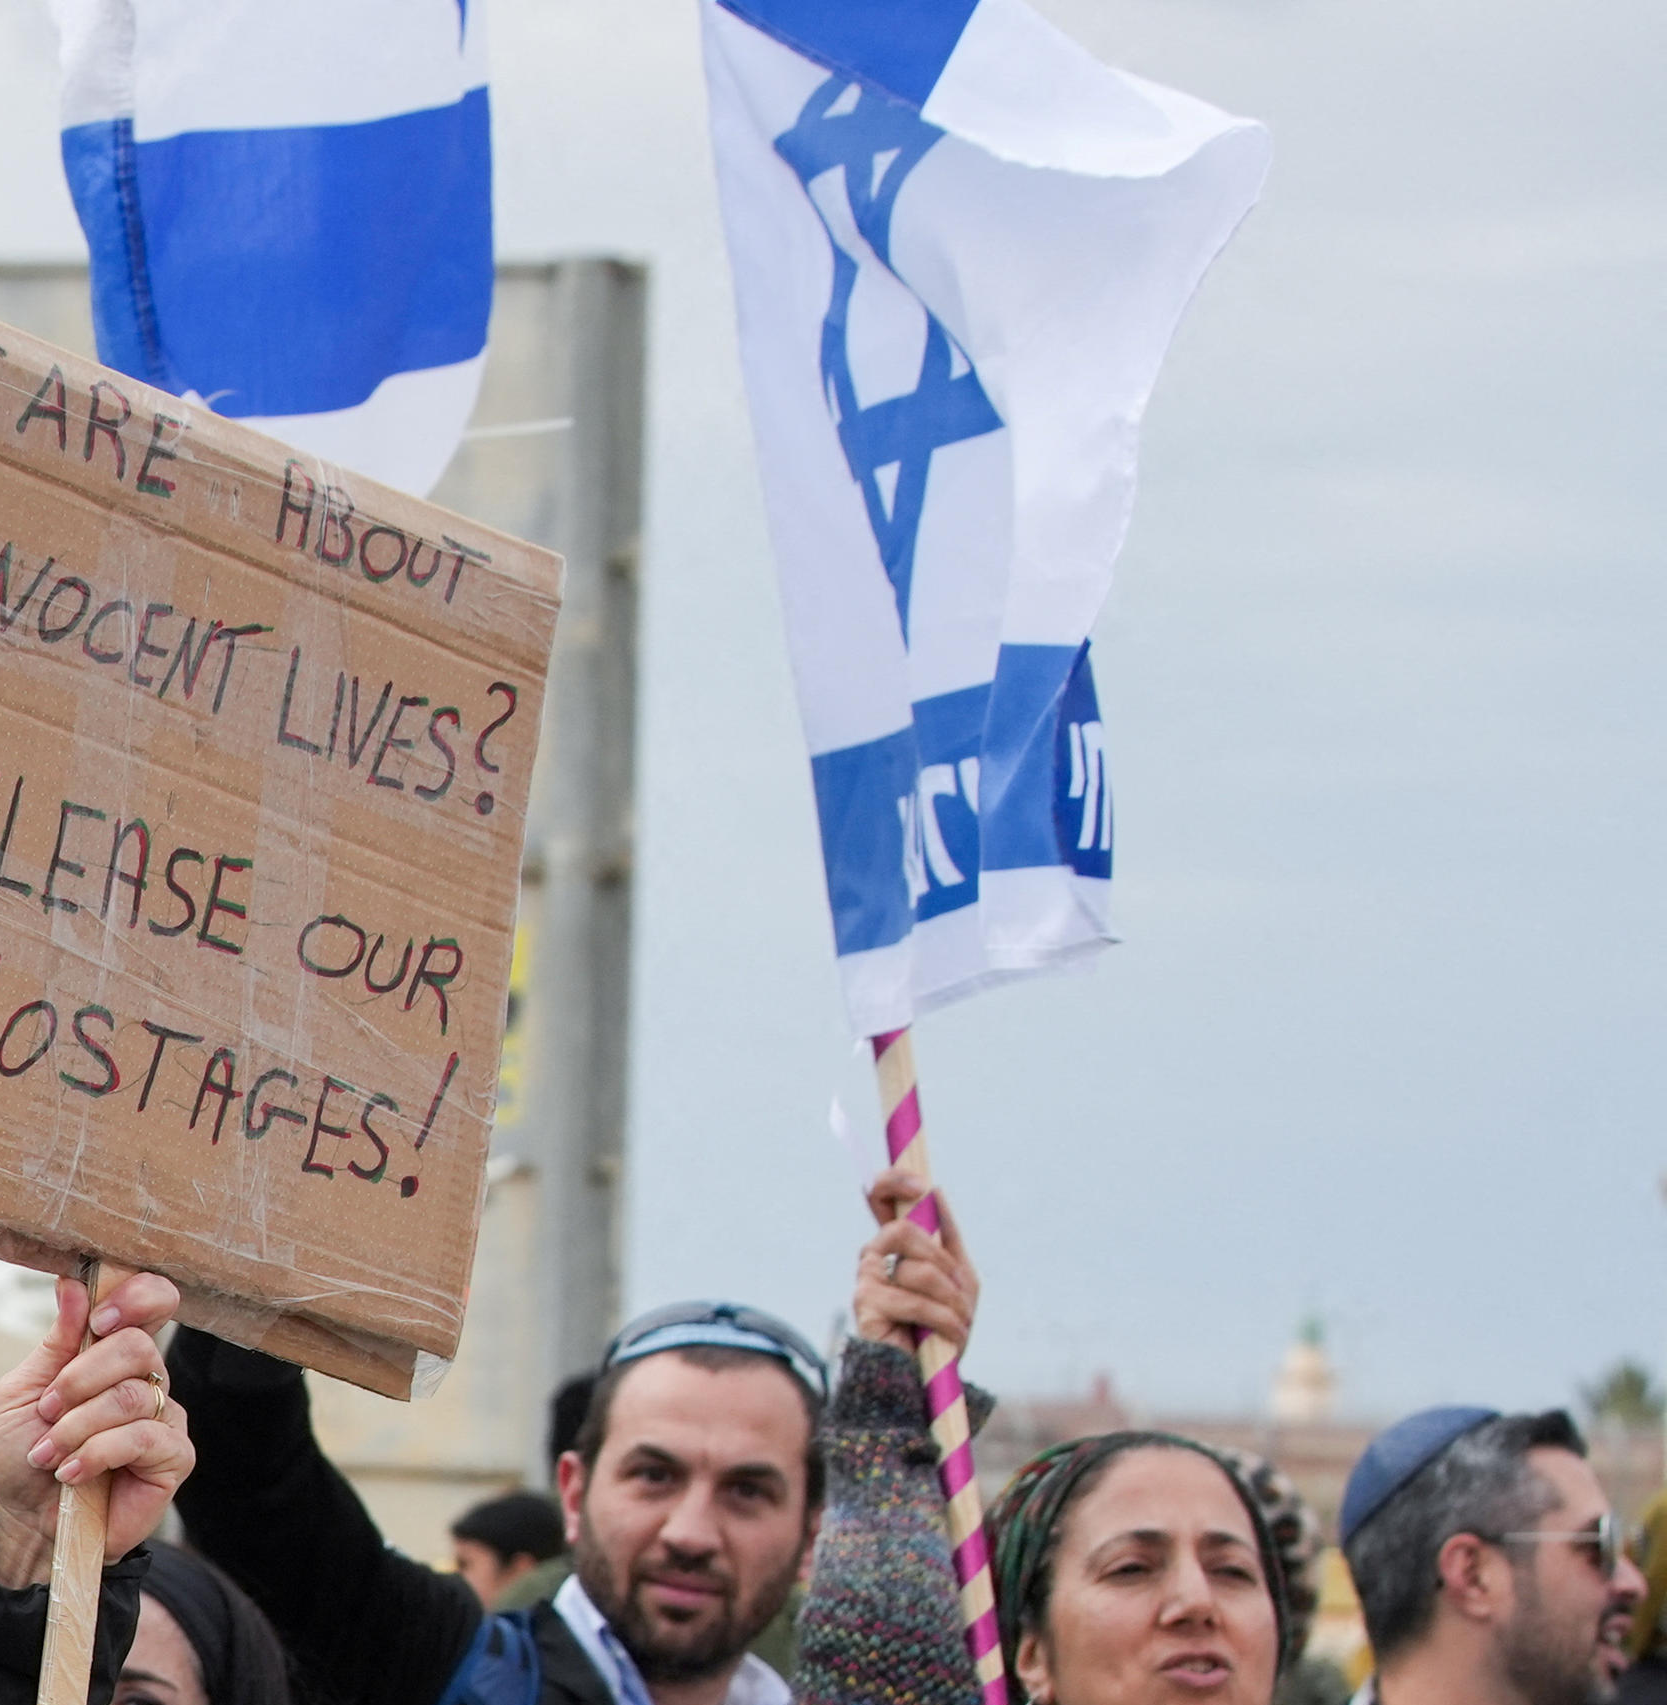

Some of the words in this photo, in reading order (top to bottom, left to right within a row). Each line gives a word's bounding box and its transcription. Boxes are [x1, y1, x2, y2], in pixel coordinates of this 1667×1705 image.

[275, 459, 492, 605] ABOUT
[276, 645, 520, 817] LIVES?
[296, 912, 465, 1036] OUR
